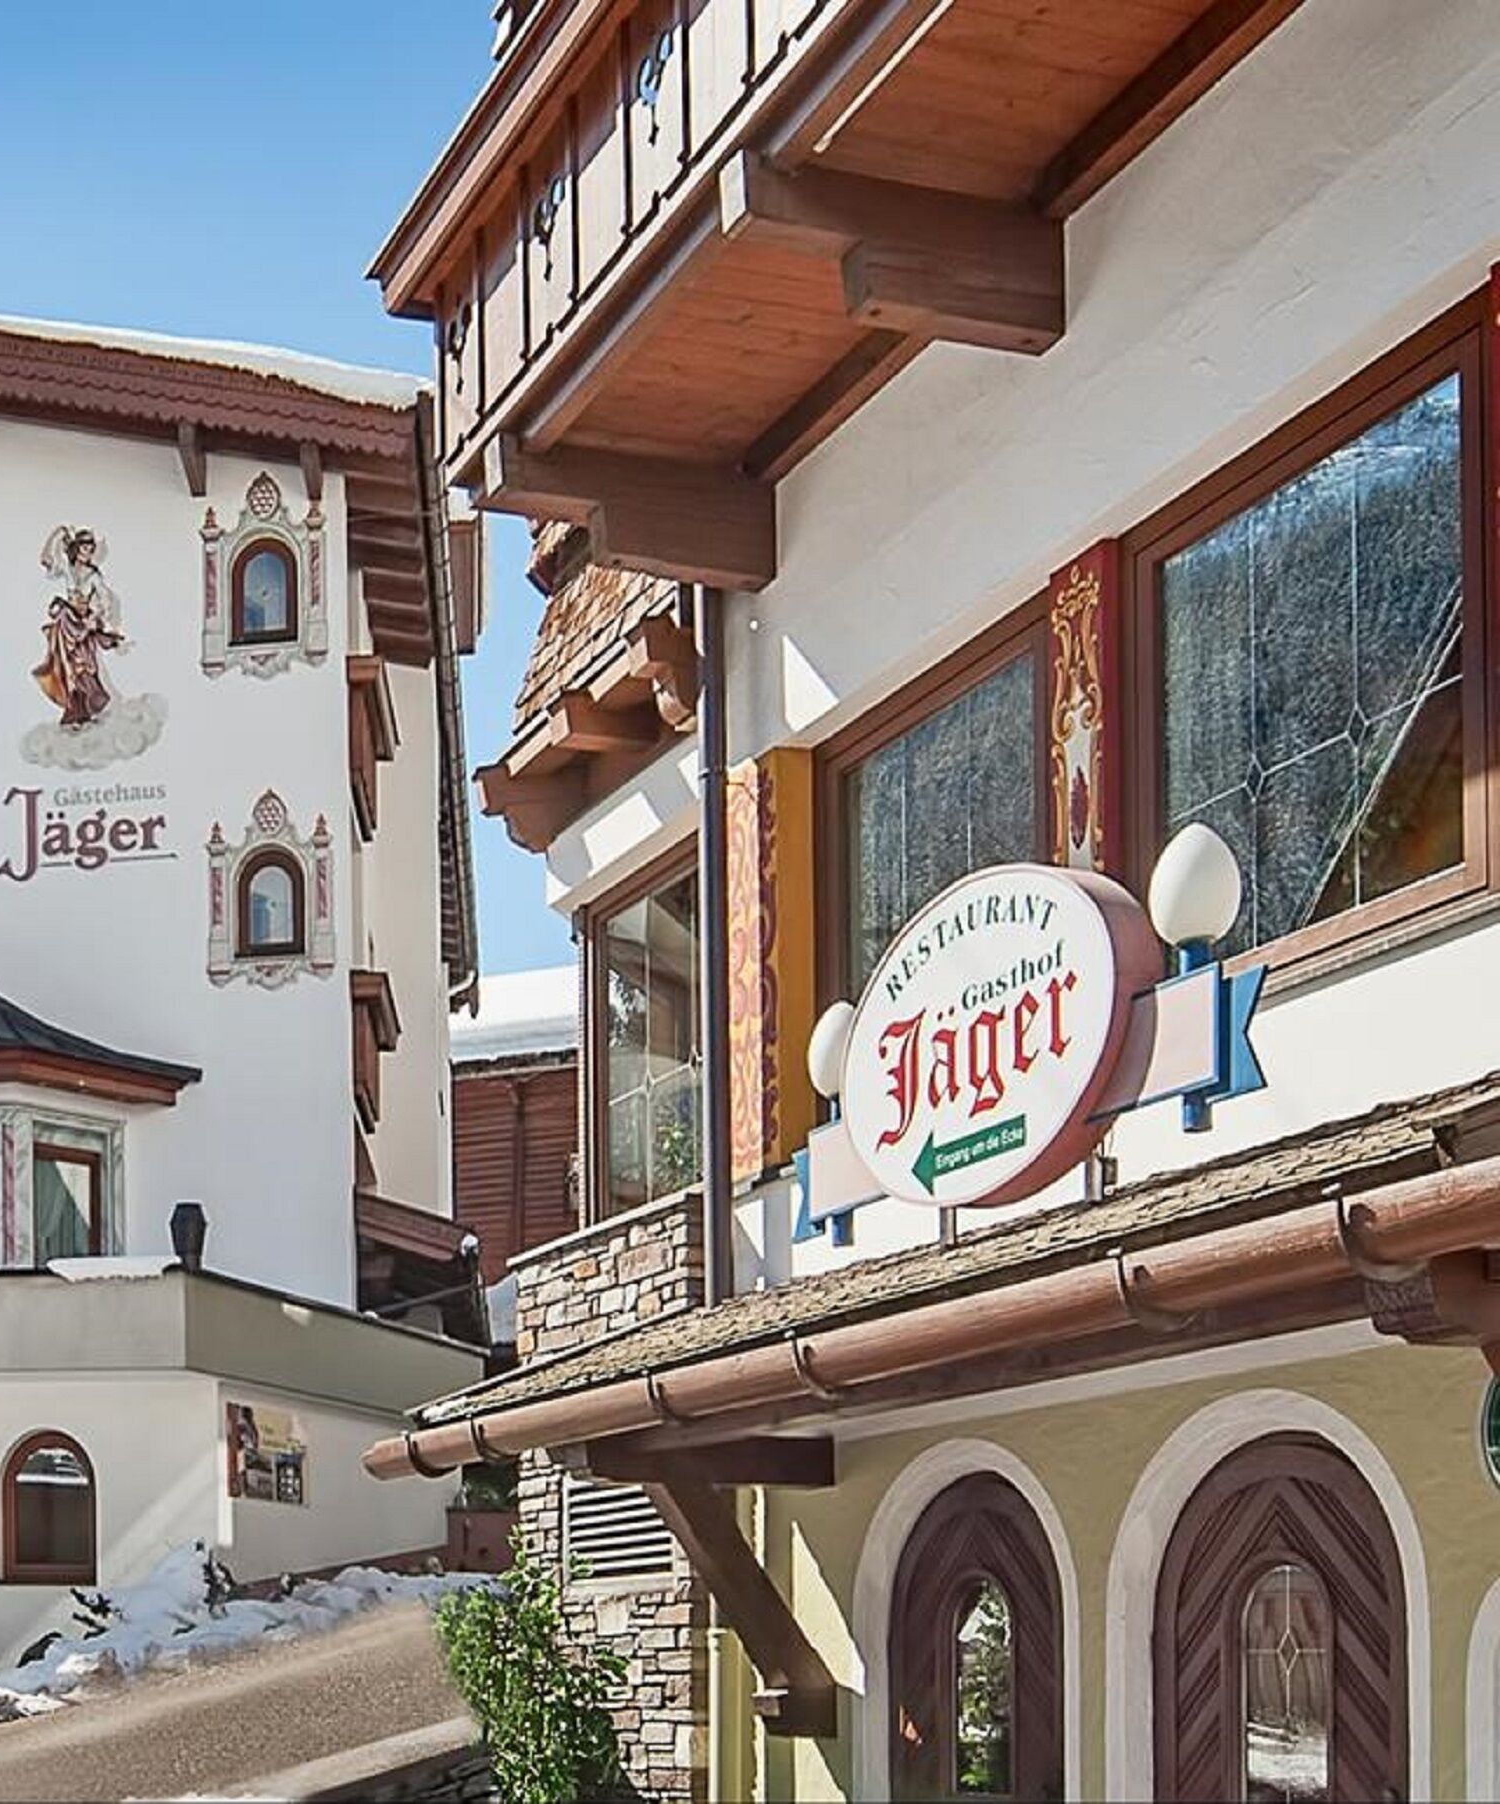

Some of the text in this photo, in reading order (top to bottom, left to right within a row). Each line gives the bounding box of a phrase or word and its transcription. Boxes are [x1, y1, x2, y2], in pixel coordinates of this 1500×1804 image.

[53, 784, 167, 807] Gästehaus
[884, 893, 1058, 1003] RESTAURANT
[961, 937, 1066, 1012] Gasthof
[876, 970, 1077, 1153] Jäger
